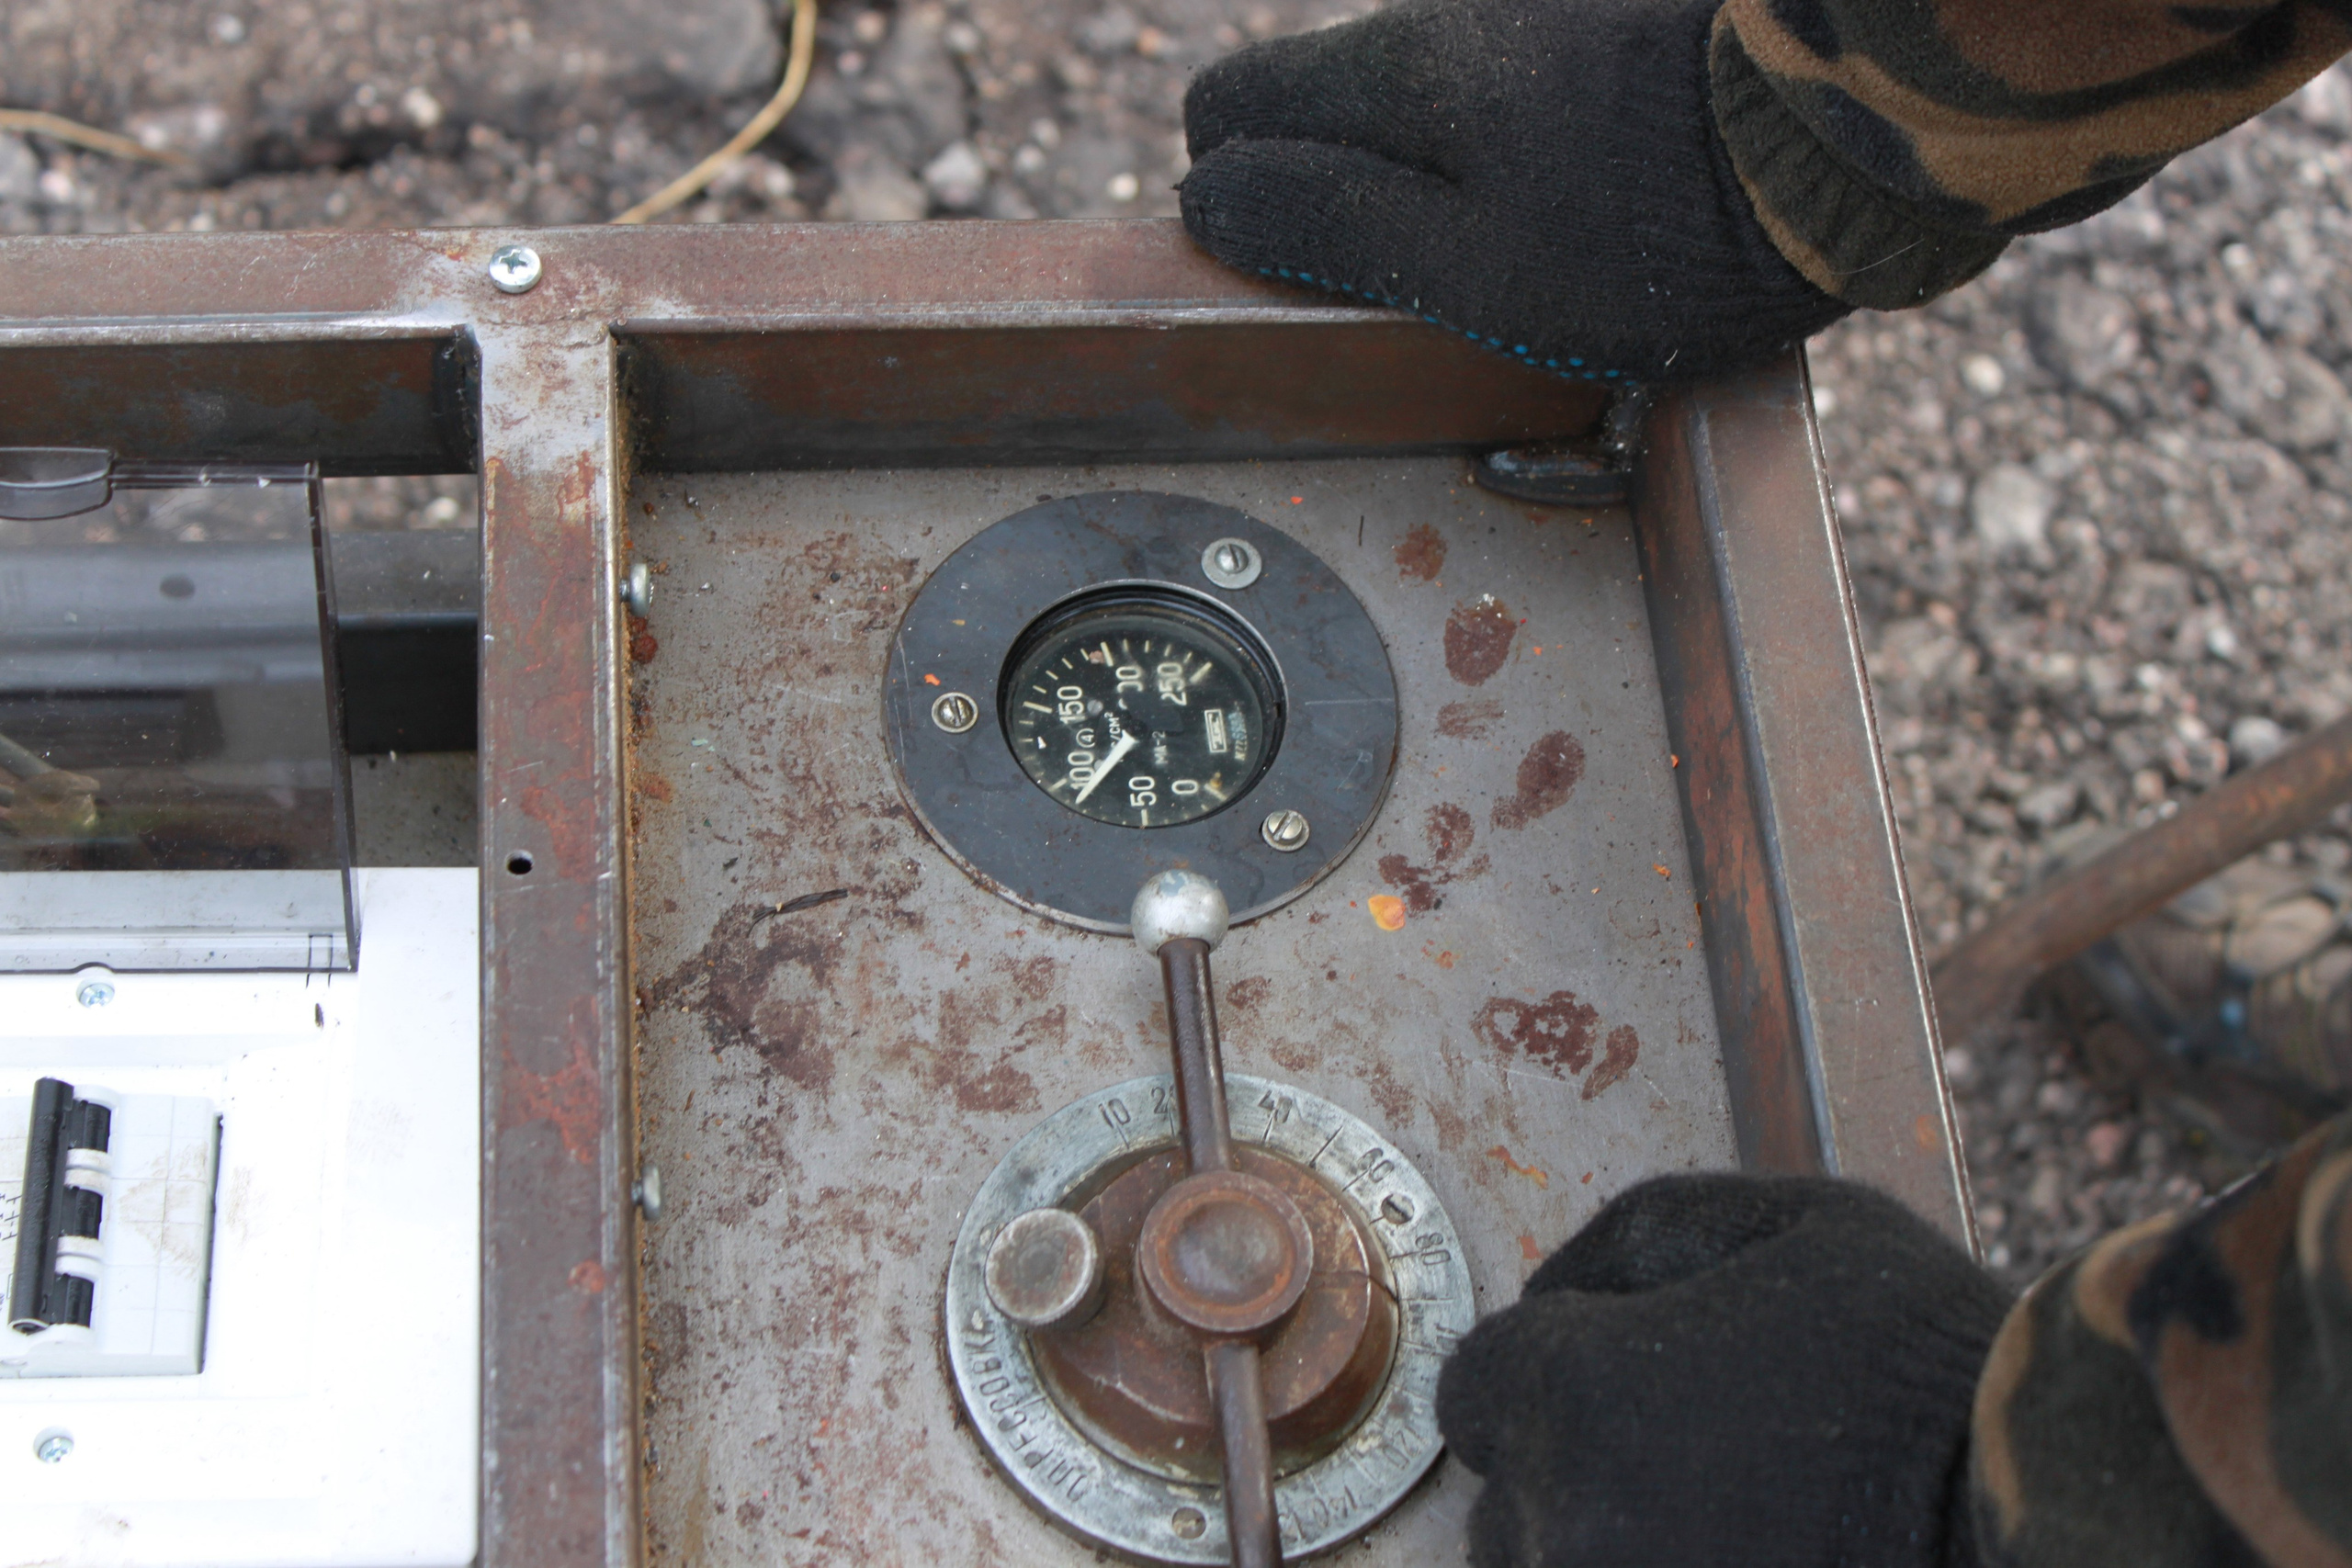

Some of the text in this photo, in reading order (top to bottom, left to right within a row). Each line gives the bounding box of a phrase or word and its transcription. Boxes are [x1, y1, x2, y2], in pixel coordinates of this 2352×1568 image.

[1158, 661, 1187, 706] 250
[1057, 684, 1086, 726] 150
[1129, 776, 1157, 807] 50
[1171, 779, 1199, 795] 0
[1099, 1098, 1130, 1127] 10
[1258, 1092, 1293, 1123] 40
